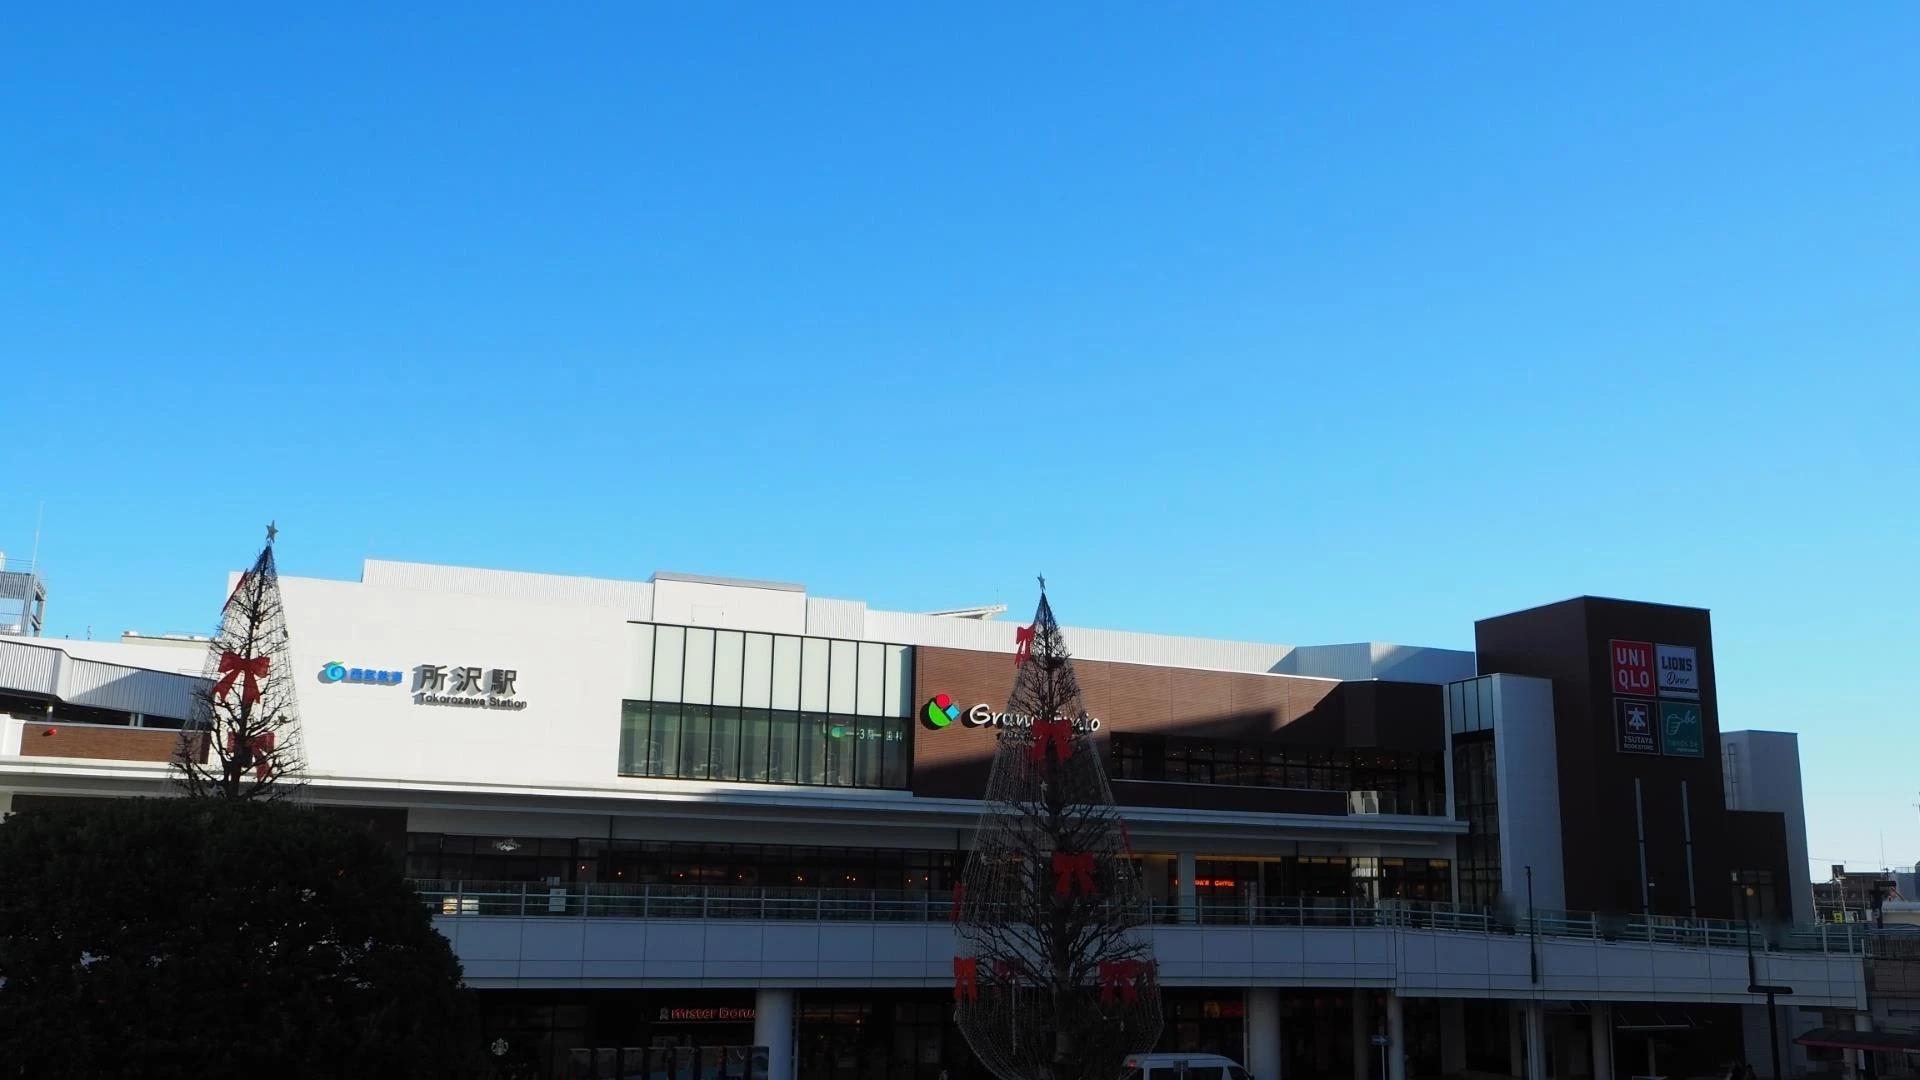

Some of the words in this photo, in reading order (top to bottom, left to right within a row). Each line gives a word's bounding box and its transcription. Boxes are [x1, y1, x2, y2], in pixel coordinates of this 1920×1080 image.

[1616, 647, 1646, 667] UNI
[1661, 656, 1693, 672] LIONS
[419, 664, 517, 695] 所沢駅
[1618, 668, 1650, 690] QLO
[419, 692, 486, 707] Tokorozawa
[488, 696, 528, 709] Station
[969, 703, 1044, 728] Gran
[1623, 735, 1654, 745] TSUTAYA
[719, 1006, 757, 1020] Donu
